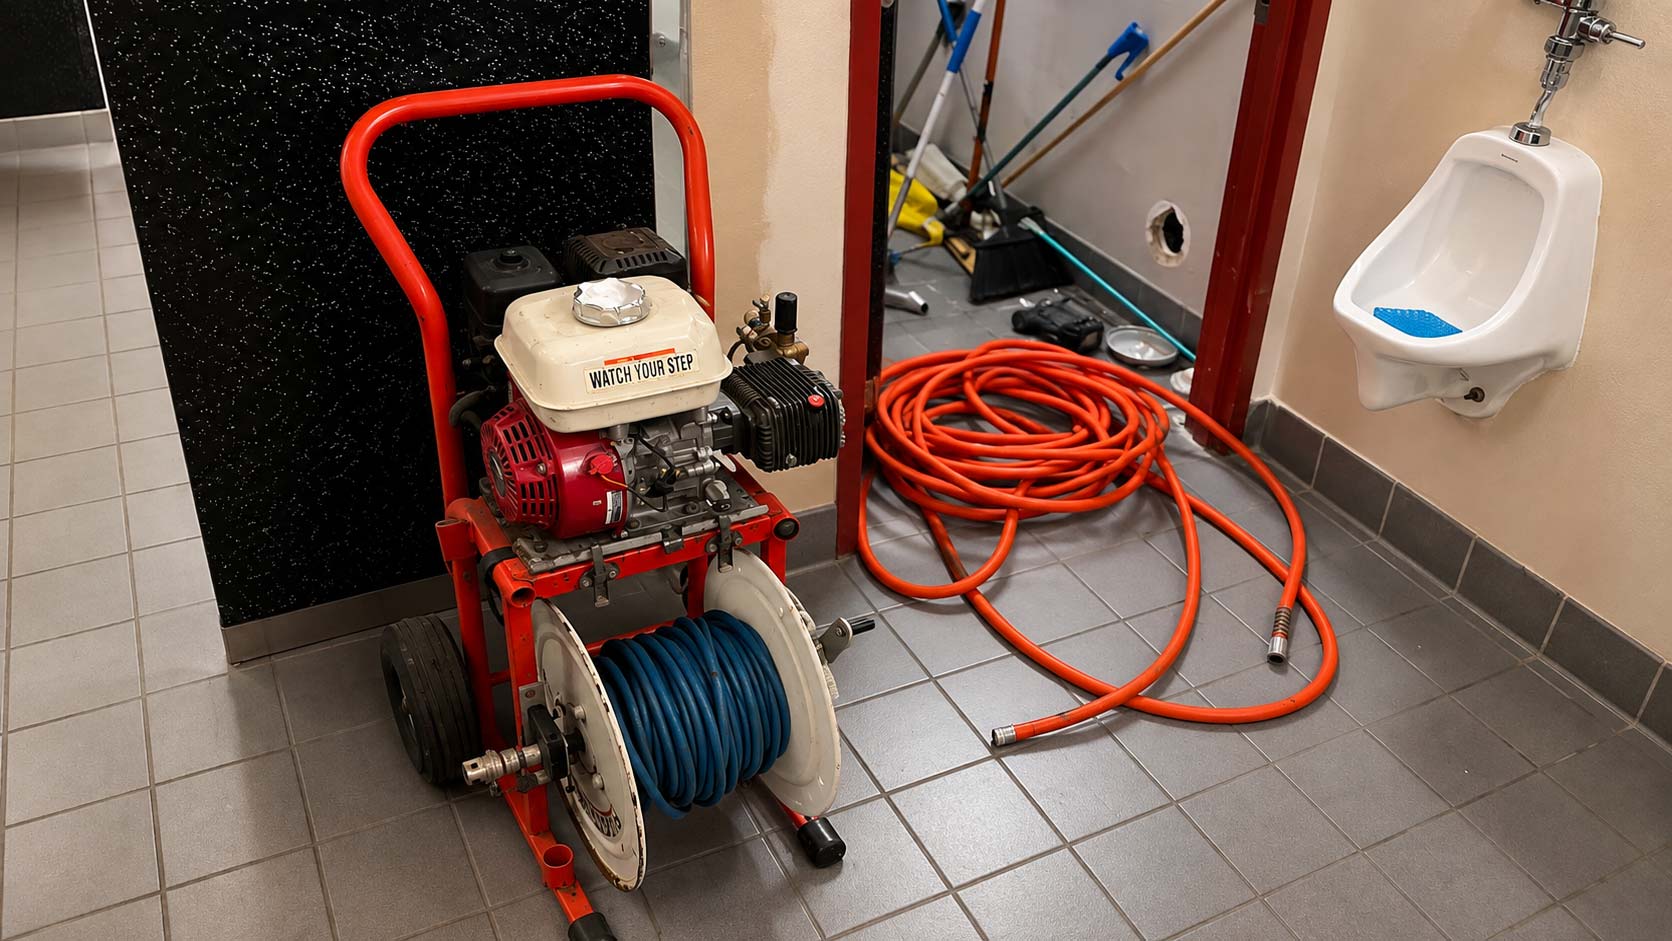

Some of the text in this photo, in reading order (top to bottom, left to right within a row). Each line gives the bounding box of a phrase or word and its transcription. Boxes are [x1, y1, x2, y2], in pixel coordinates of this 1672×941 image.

[589, 353, 694, 389] WATCH YOUR STEP
